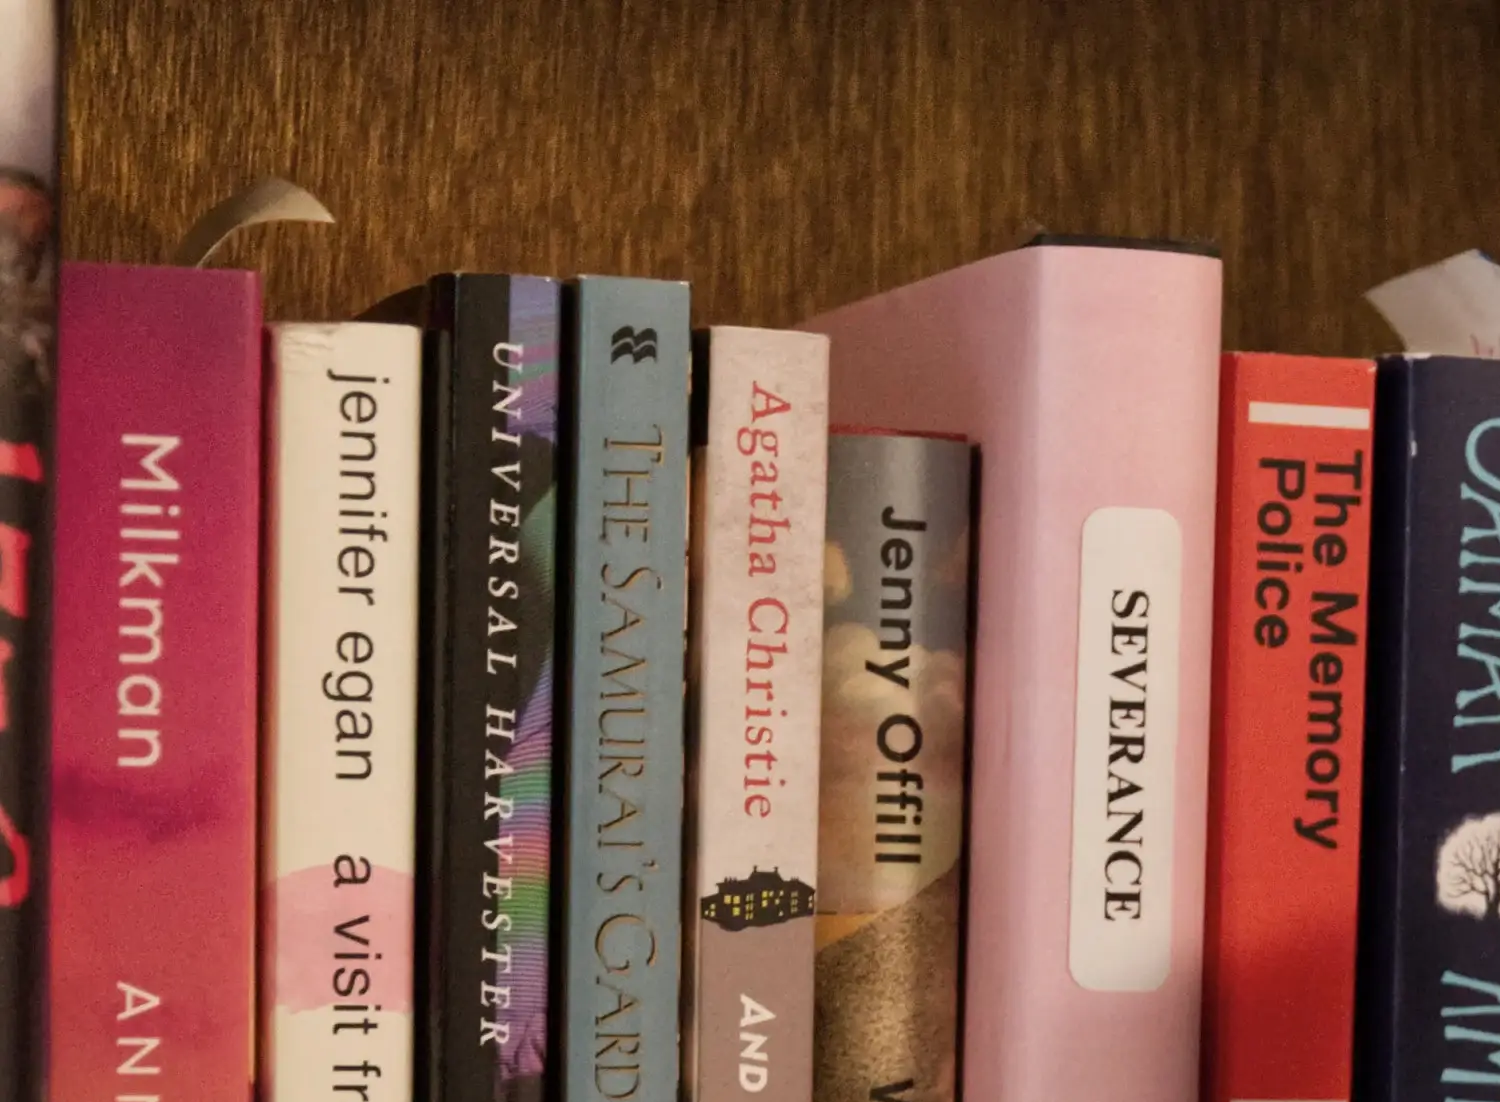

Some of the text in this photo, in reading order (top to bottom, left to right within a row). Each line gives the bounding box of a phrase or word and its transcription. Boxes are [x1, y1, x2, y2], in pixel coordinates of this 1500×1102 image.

[117, 434, 181, 768] Milkman
[322, 368, 390, 780] jennifer egan
[600, 424, 665, 543] THE
[737, 381, 792, 819] Agatha Christie
[1254, 456, 1306, 649] Police
[1293, 449, 1363, 850] The Memory
[480, 342, 524, 1047] UNIVERSAL HARVESTER
[596, 564, 662, 893] SAMURAI'S
[864, 506, 927, 865] Jenny Offill
[1103, 588, 1150, 922] SEVERANCE
[332, 915, 382, 1035] visit
[333, 855, 372, 888] a
[738, 993, 777, 1093] AND
